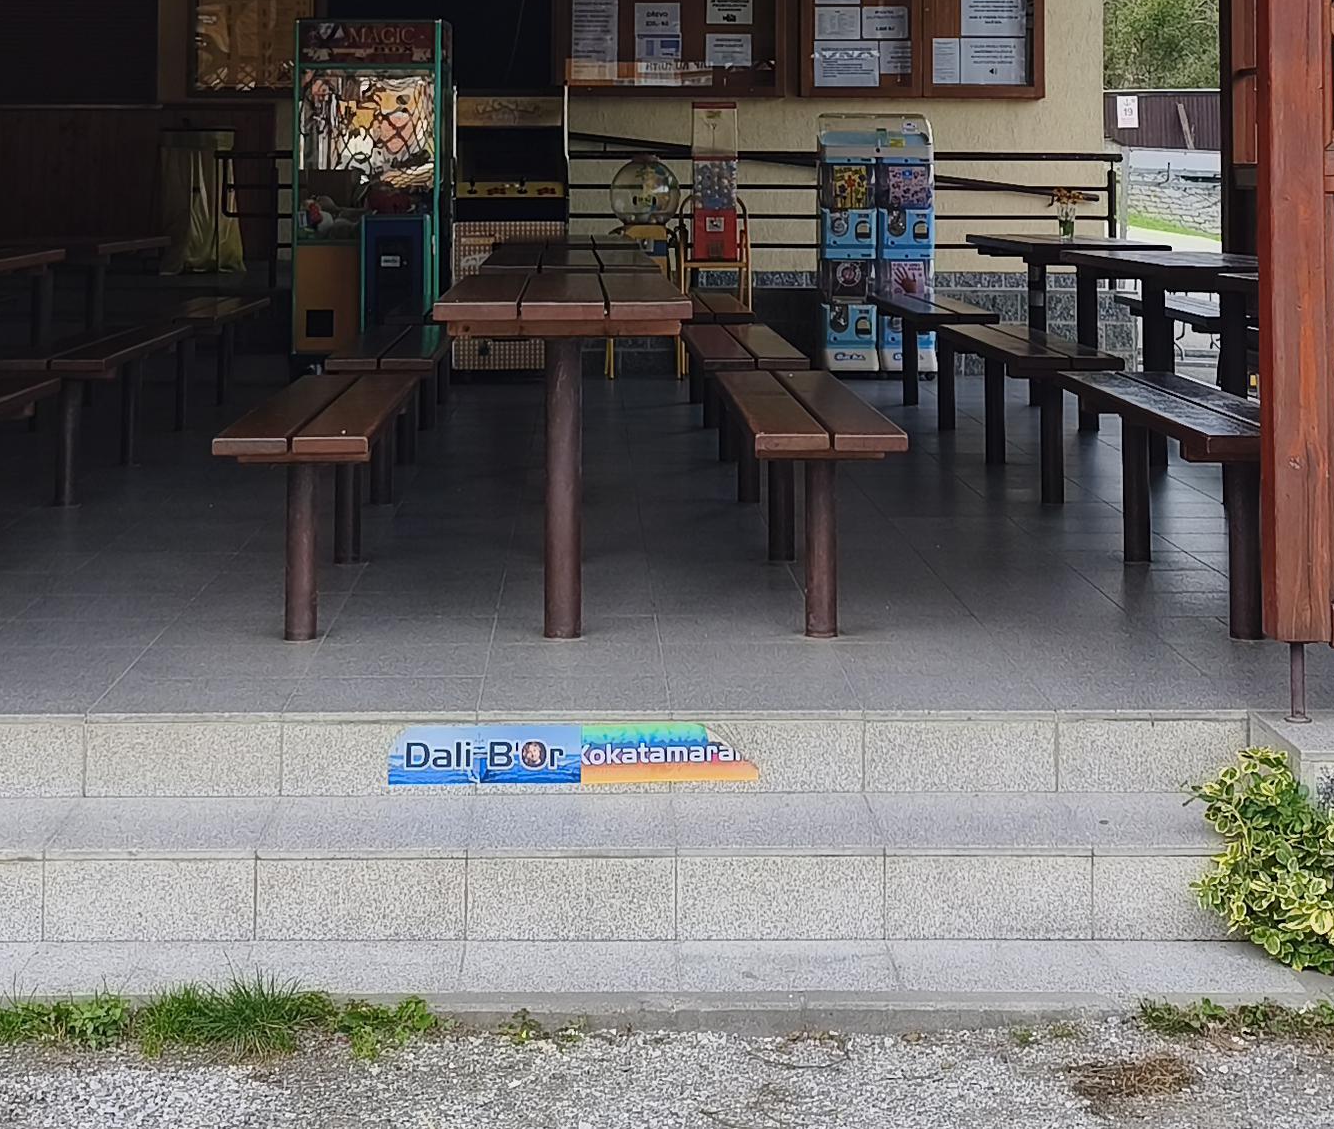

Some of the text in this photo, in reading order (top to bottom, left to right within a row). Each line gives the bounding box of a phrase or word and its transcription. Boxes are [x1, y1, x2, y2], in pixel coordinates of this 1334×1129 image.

[349, 27, 415, 43] MAGIC
[1123, 107, 1133, 117] 19
[405, 740, 471, 770] Dali
